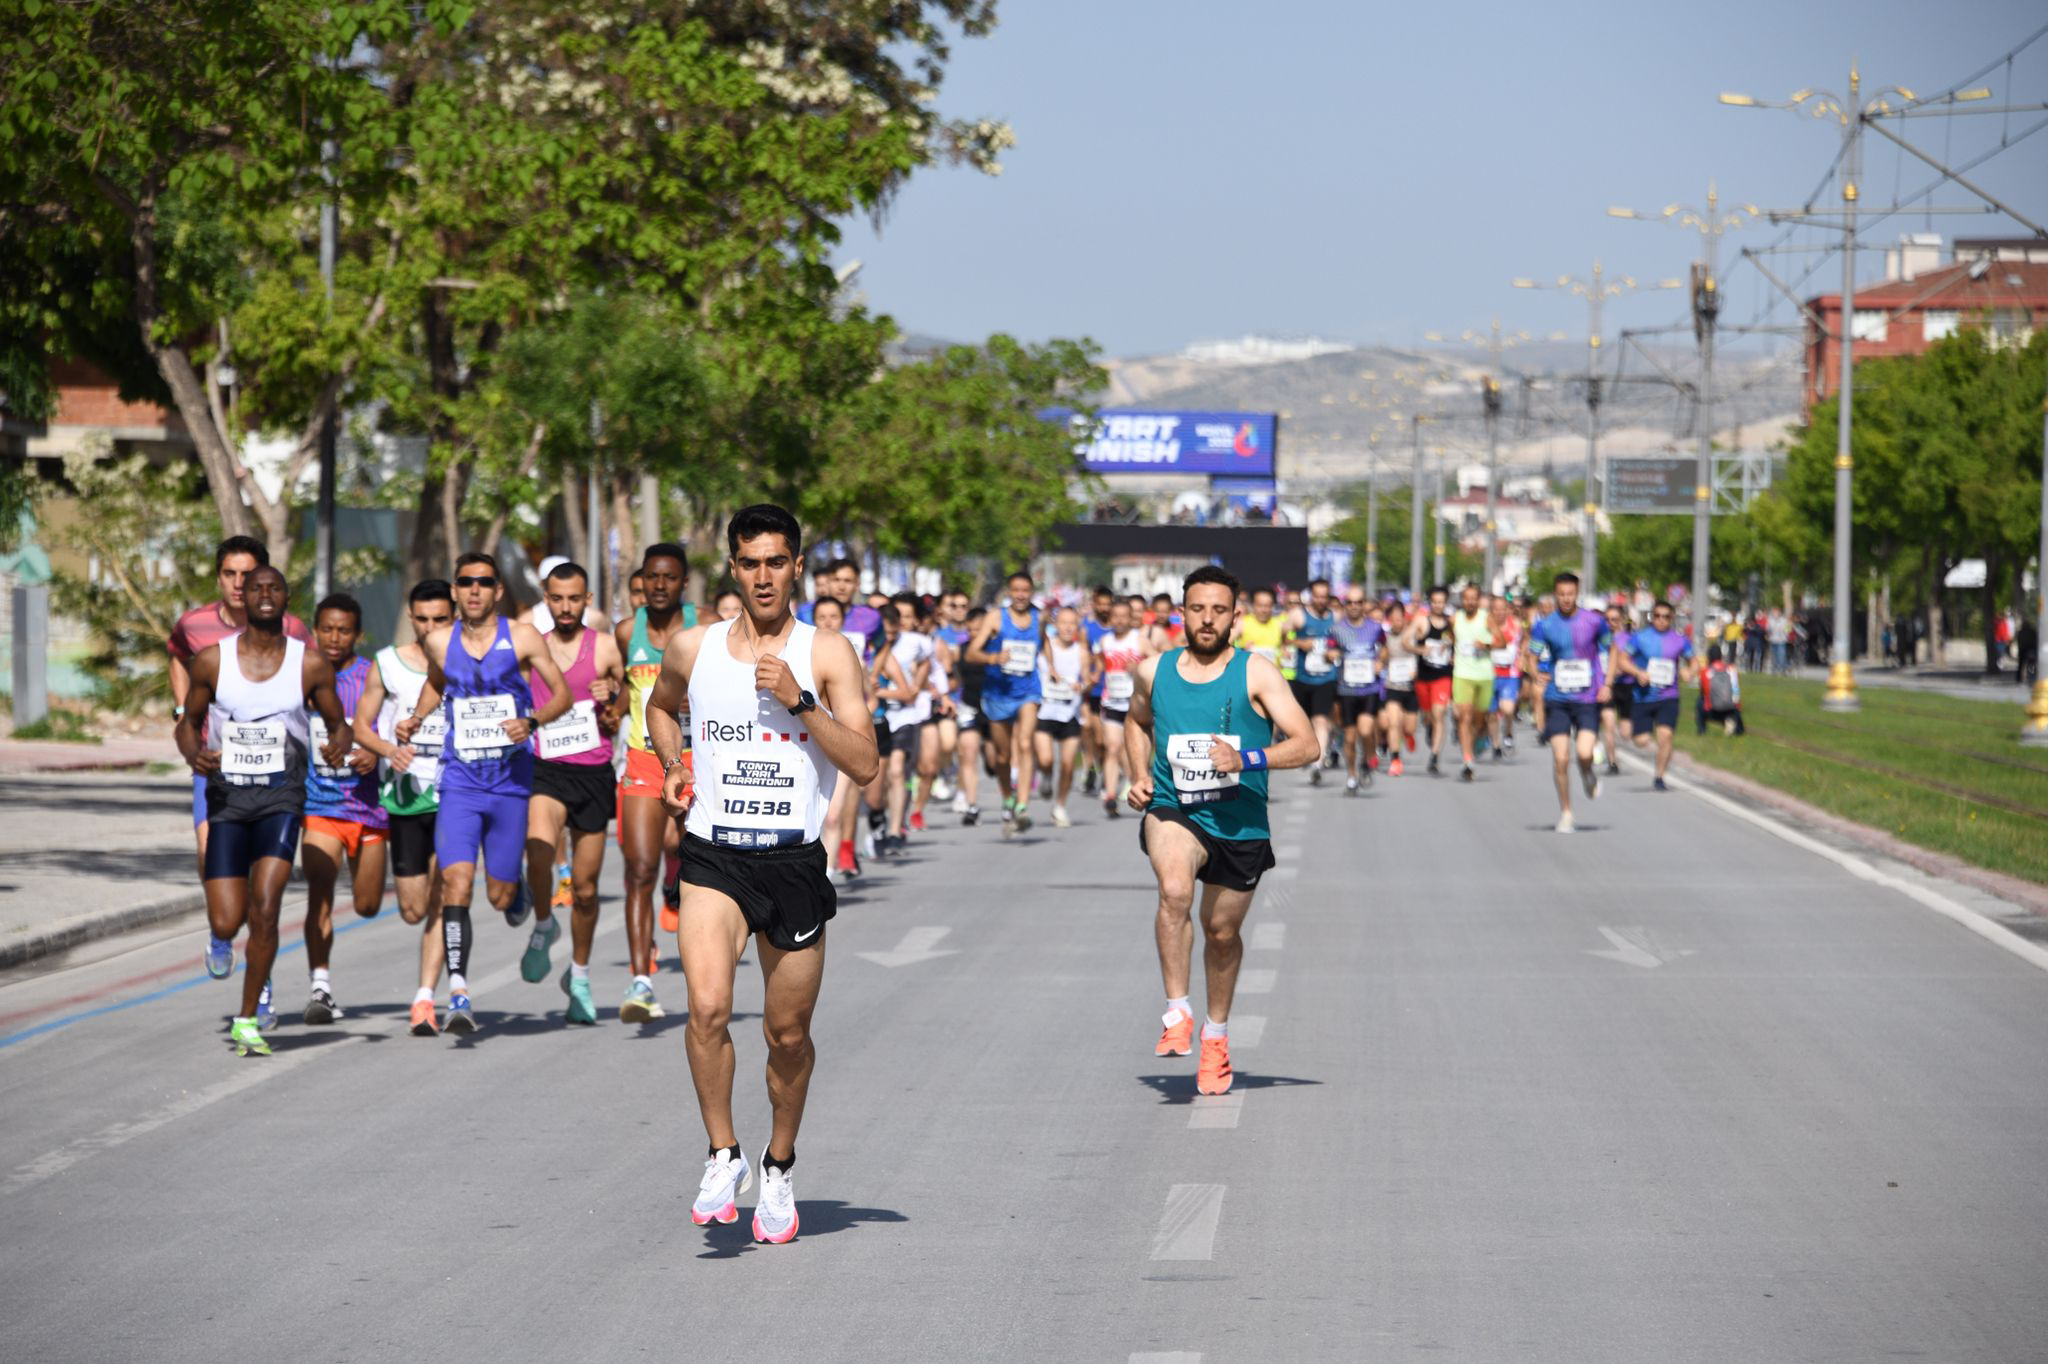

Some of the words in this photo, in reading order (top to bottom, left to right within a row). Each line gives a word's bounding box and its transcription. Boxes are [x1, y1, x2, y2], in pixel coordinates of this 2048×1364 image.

[701, 720, 753, 742] iRest
[546, 732, 589, 749] 10845
[233, 753, 272, 765] 11087
[739, 762, 778, 771] KONYA
[745, 770, 772, 778] YARI
[726, 776, 790, 786] MARATONU
[723, 799, 791, 816] 10538
